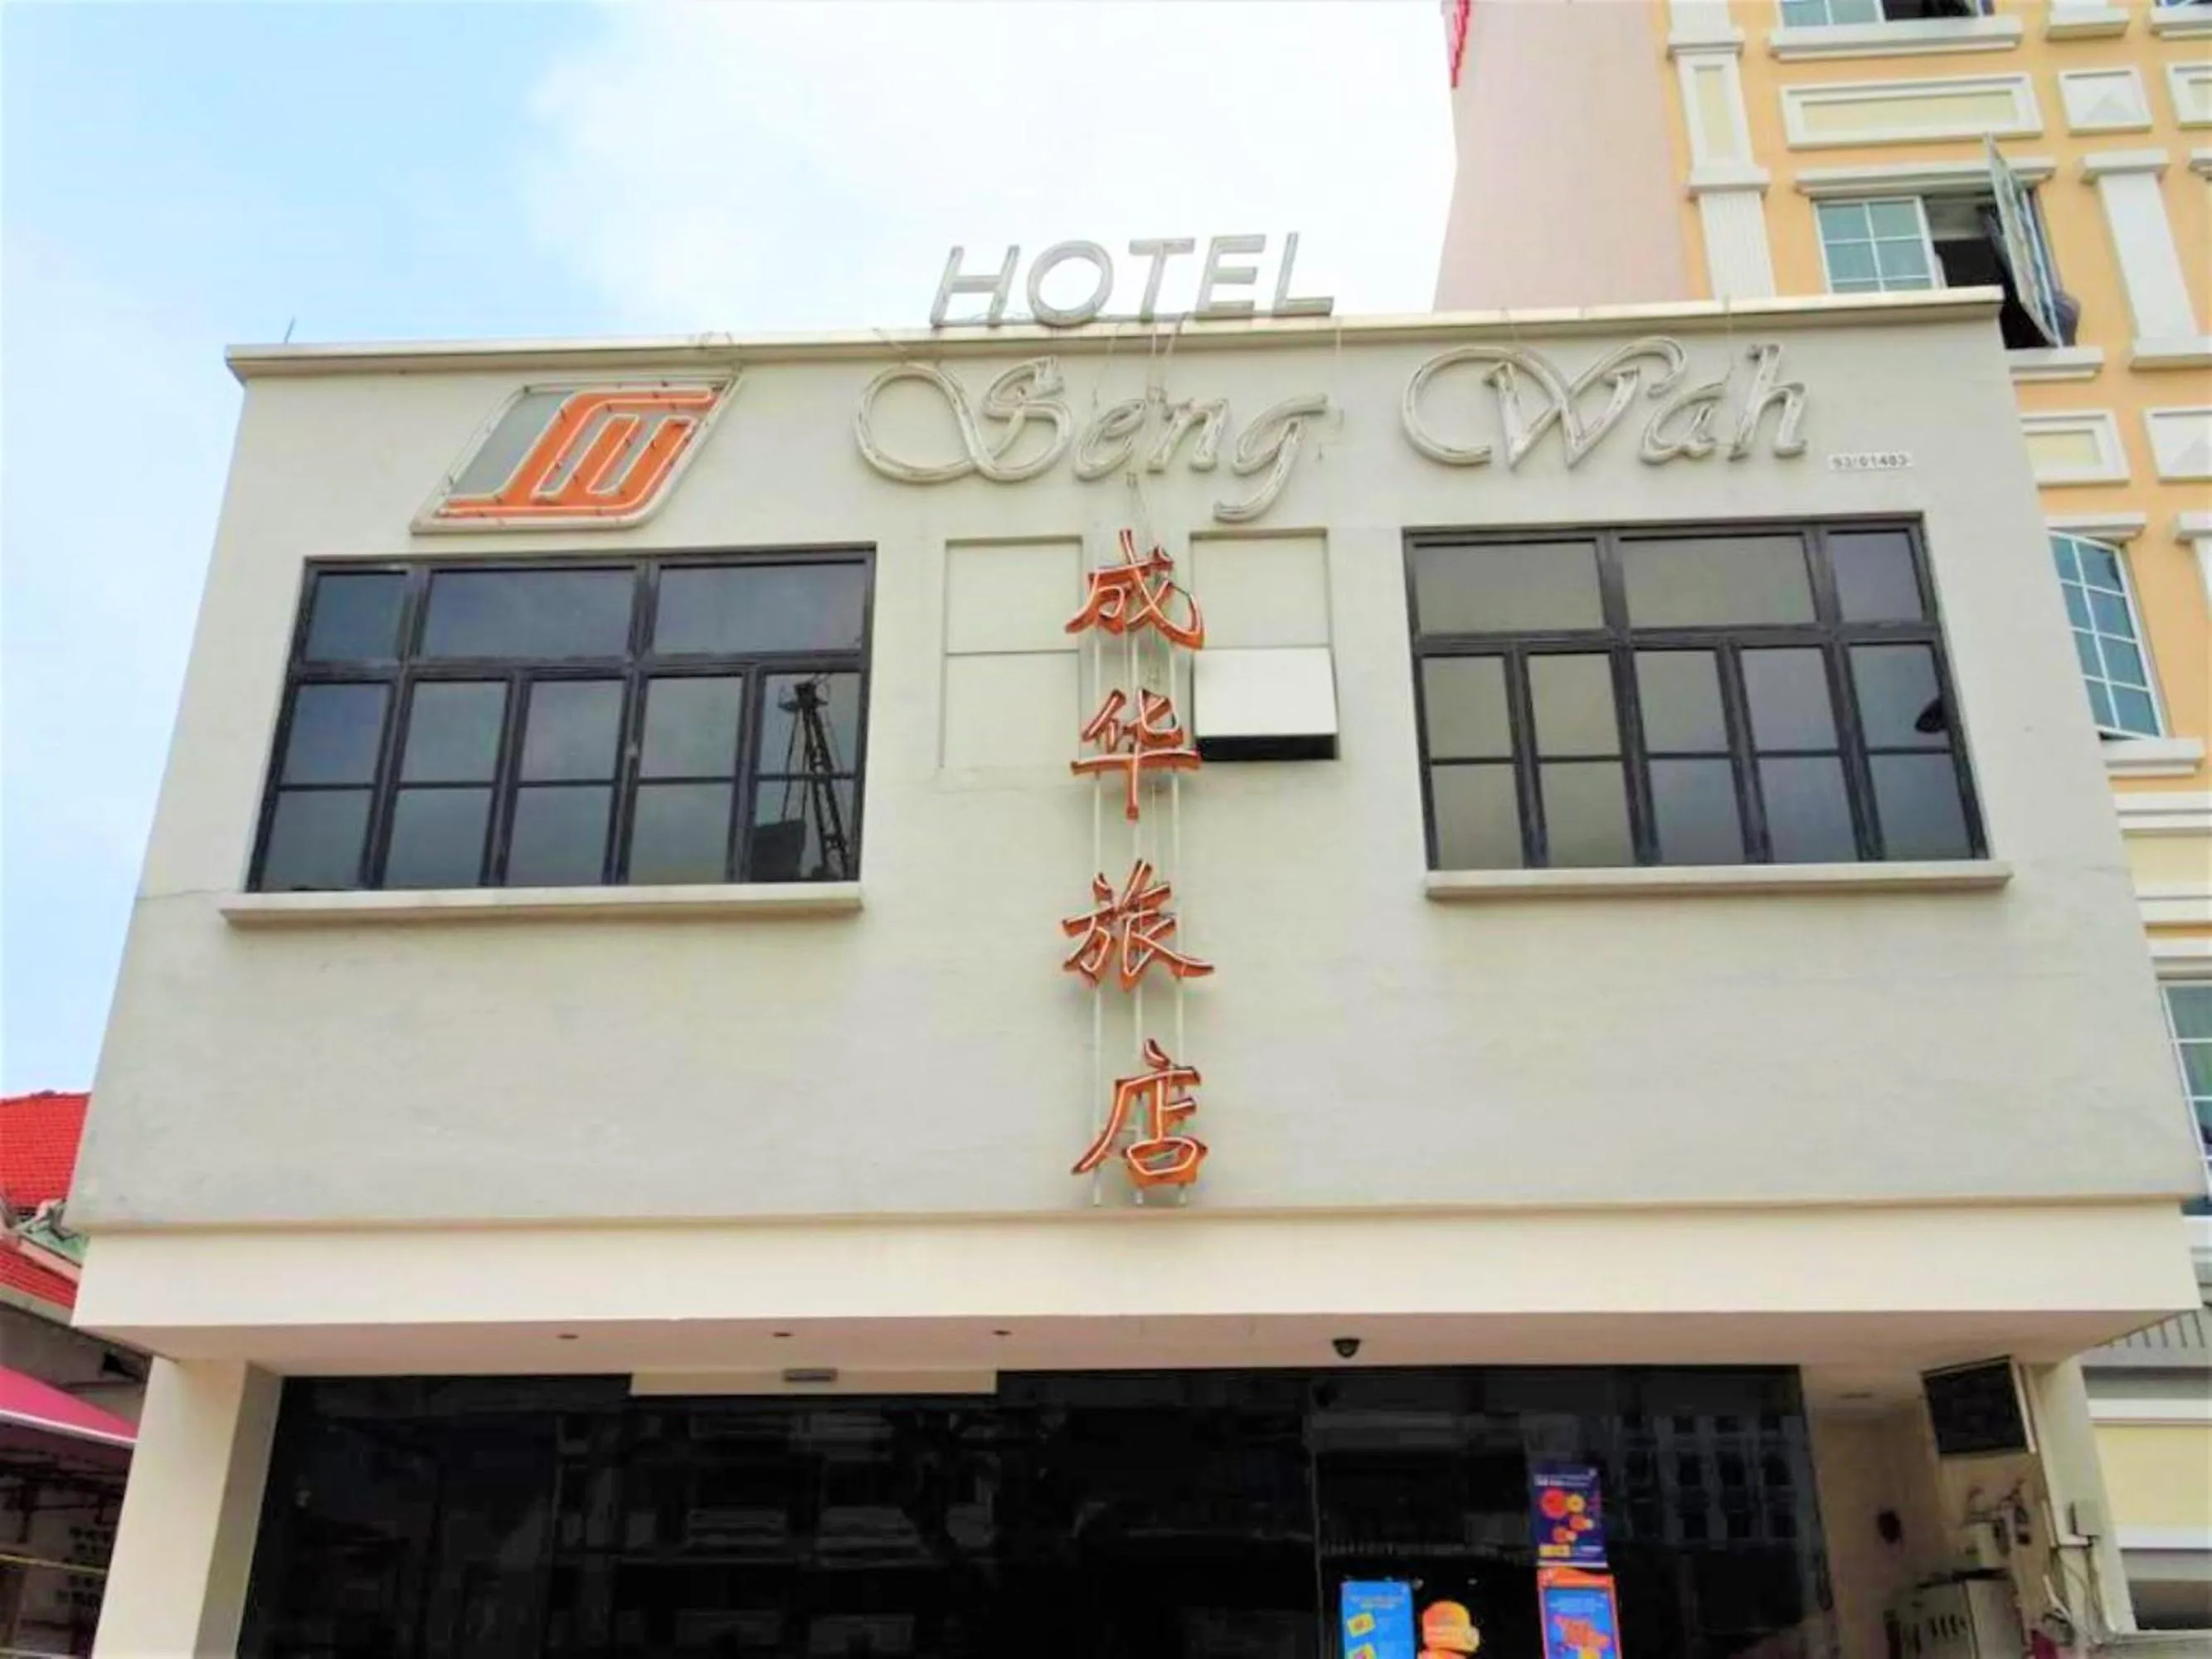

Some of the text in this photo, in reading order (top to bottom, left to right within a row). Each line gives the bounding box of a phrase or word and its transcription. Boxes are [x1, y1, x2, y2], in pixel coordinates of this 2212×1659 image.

[930, 231, 1334, 328] HOTEL
[854, 336, 1807, 522] Seng Wah
[1063, 528, 1214, 1189] 成华旅店
